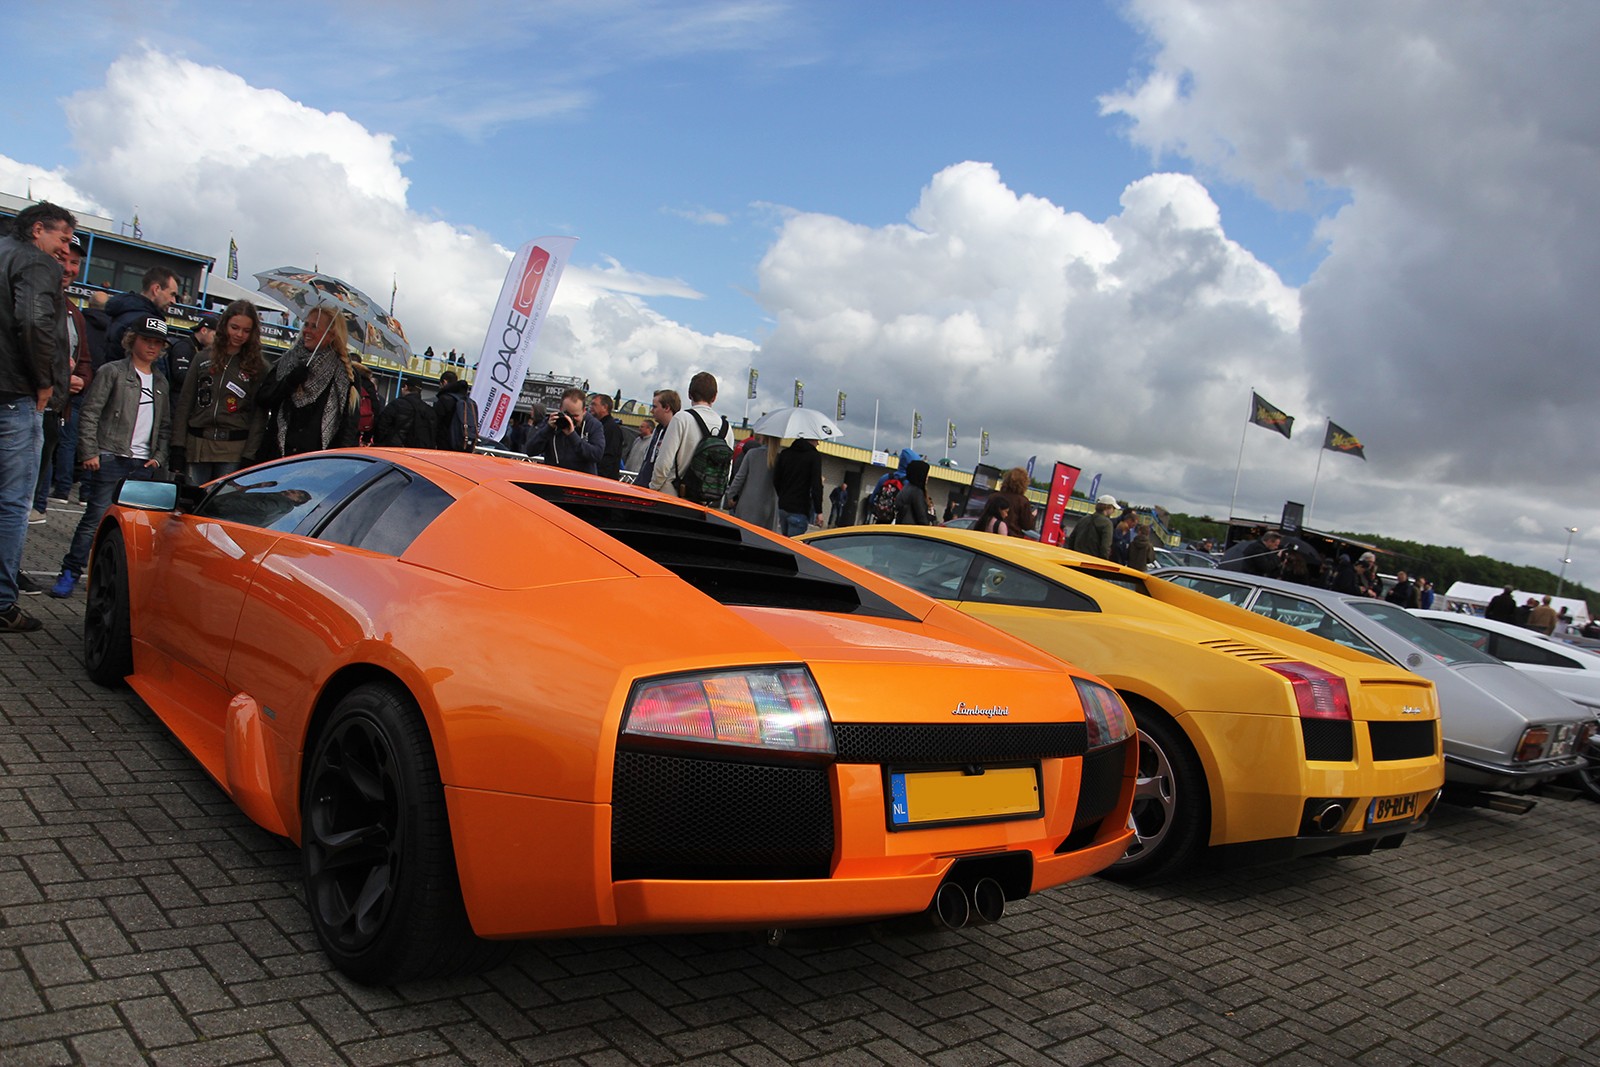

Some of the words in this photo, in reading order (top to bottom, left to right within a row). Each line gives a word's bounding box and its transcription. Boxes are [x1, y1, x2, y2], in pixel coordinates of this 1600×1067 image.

[510, 354, 525, 387] Premium
[521, 312, 540, 353] Automotive
[1047, 474, 1070, 543] TESL
[951, 701, 1009, 718] Lamborghini
[893, 803, 906, 815] NL
